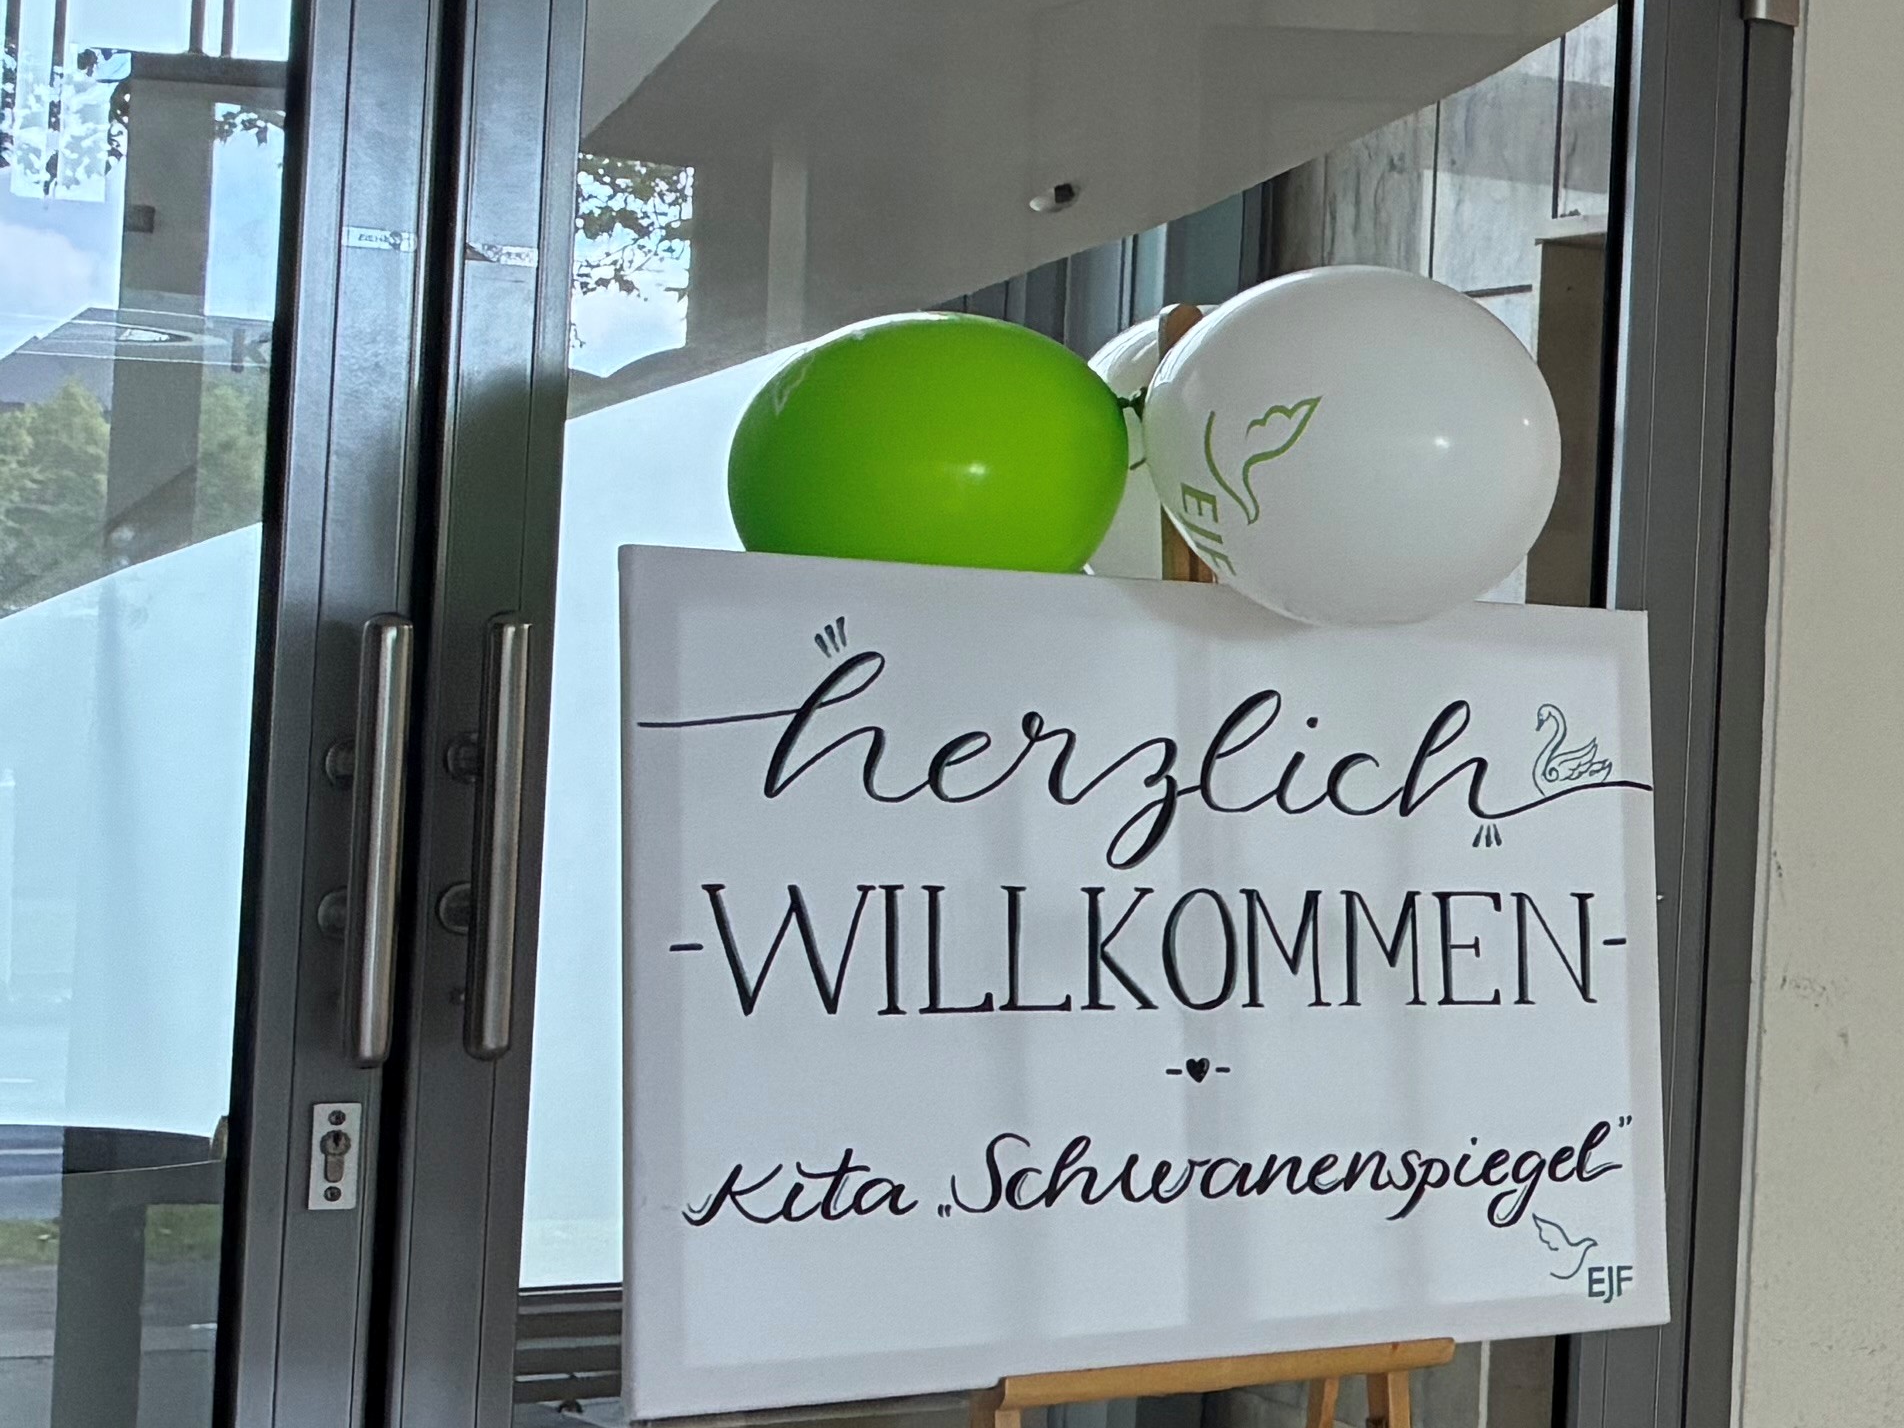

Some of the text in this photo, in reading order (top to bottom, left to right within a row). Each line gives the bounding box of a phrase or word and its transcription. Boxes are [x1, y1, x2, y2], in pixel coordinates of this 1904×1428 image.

[637, 650, 1653, 870] herzlich
[682, 1147, 919, 1227] Kita
[1587, 1265, 1634, 1304] EJF
